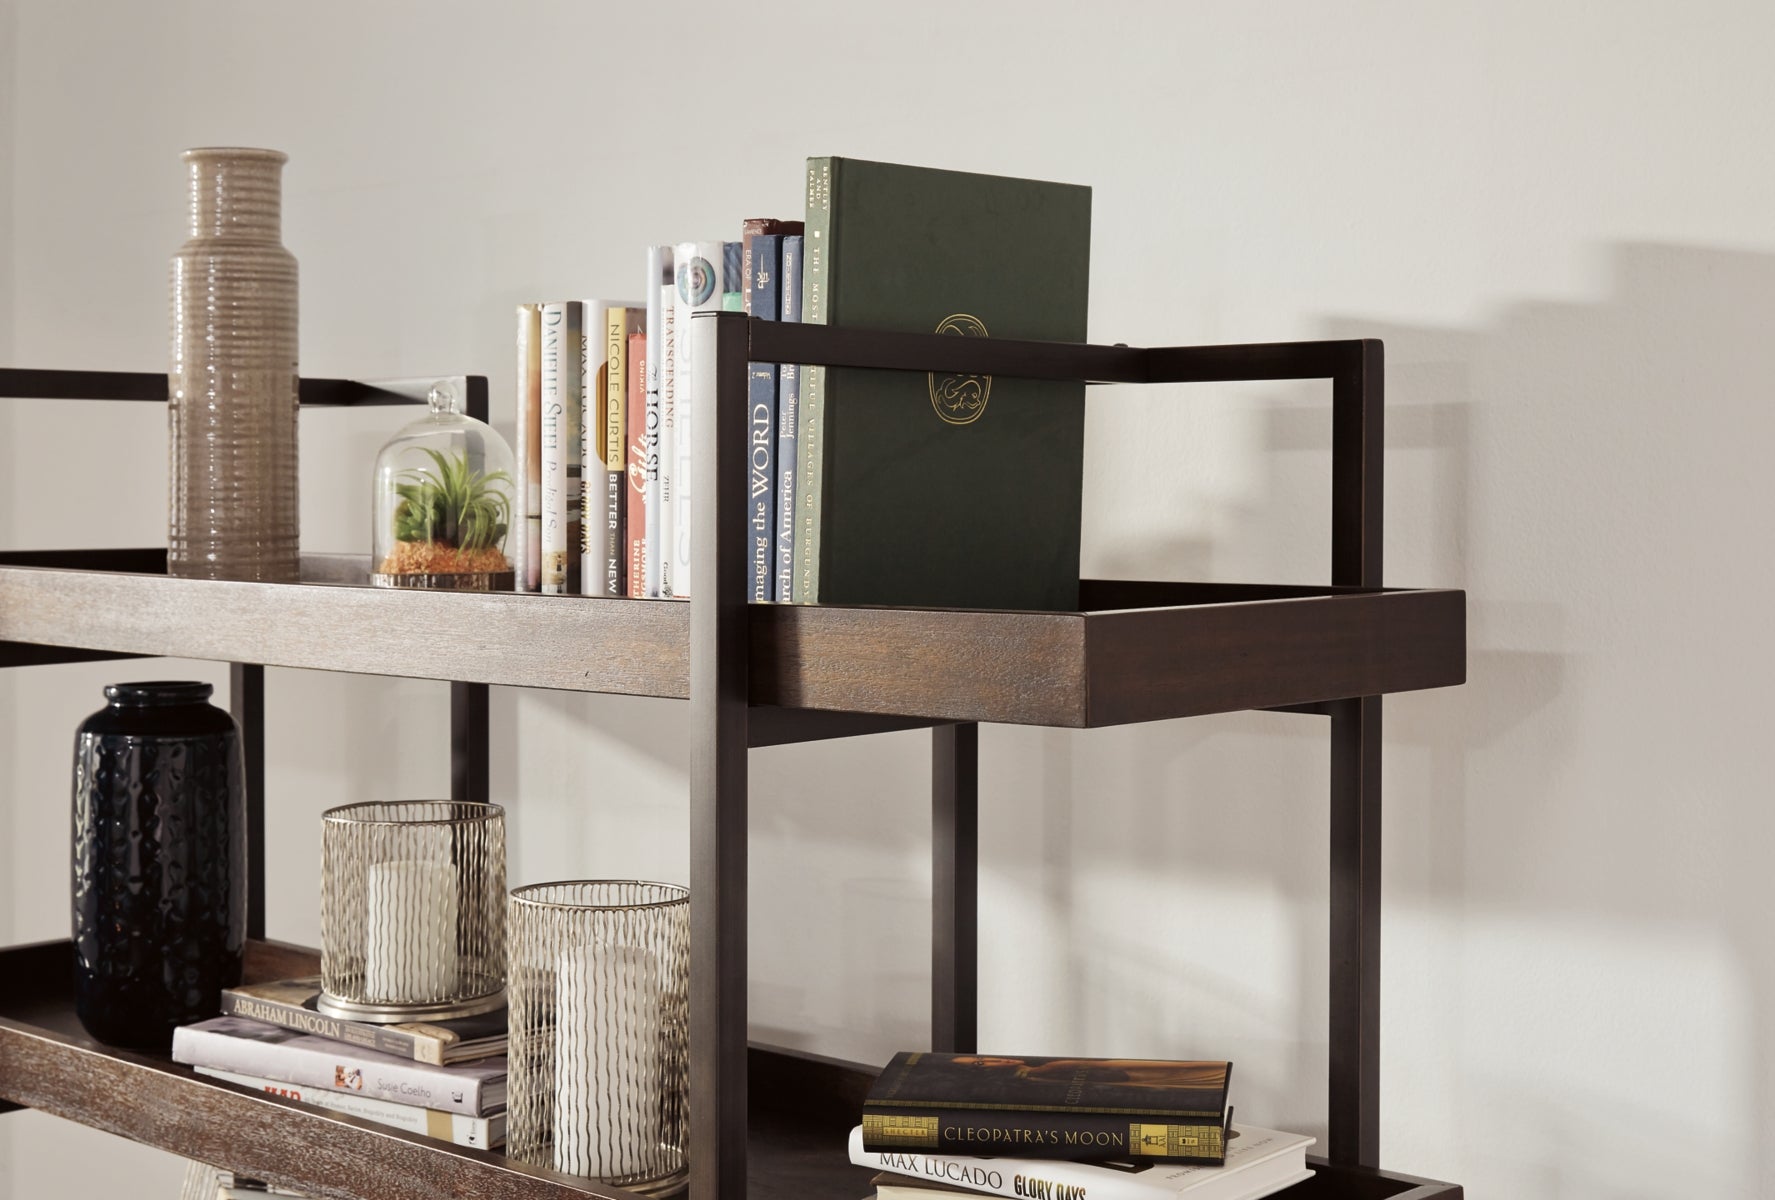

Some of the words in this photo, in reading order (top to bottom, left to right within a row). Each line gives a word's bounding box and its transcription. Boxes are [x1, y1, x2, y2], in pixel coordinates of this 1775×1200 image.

[812, 246, 820, 273] THE
[811, 283, 820, 321] MOST
[543, 310, 562, 396] DANIELLE
[609, 324, 620, 392] NICOLE
[664, 305, 675, 429] TRANSCENDING
[542, 402, 563, 449] STEEL
[608, 399, 620, 462] CURTIS
[647, 389, 659, 482] HORSE
[786, 393, 798, 440] Jennings
[752, 403, 769, 499] WORD
[806, 418, 815, 486] VILLAGES
[608, 473, 618, 529] BETTER
[752, 501, 766, 531] the
[779, 470, 792, 543] America
[806, 494, 813, 508] OF
[547, 518, 558, 544] Son
[608, 533, 616, 556] THAN
[608, 559, 617, 593] NEW
[780, 545, 792, 565] of
[803, 518, 812, 598] BURGUNDY
[233, 998, 287, 1027] ABRAHAM
[287, 1012, 341, 1039] LINCOLN
[376, 1077, 399, 1094] Susie
[399, 1083, 432, 1099] Coelho
[883, 1128, 929, 1137] SHECTER
[943, 1126, 1060, 1145] CLEOPATRA'S
[1064, 1130, 1125, 1147] MOON
[879, 1152, 920, 1174] MAX
[924, 1158, 1004, 1190] LUCADO
[1013, 1173, 1054, 1200] GLORY
[1056, 1178, 1087, 1200] DAYS
